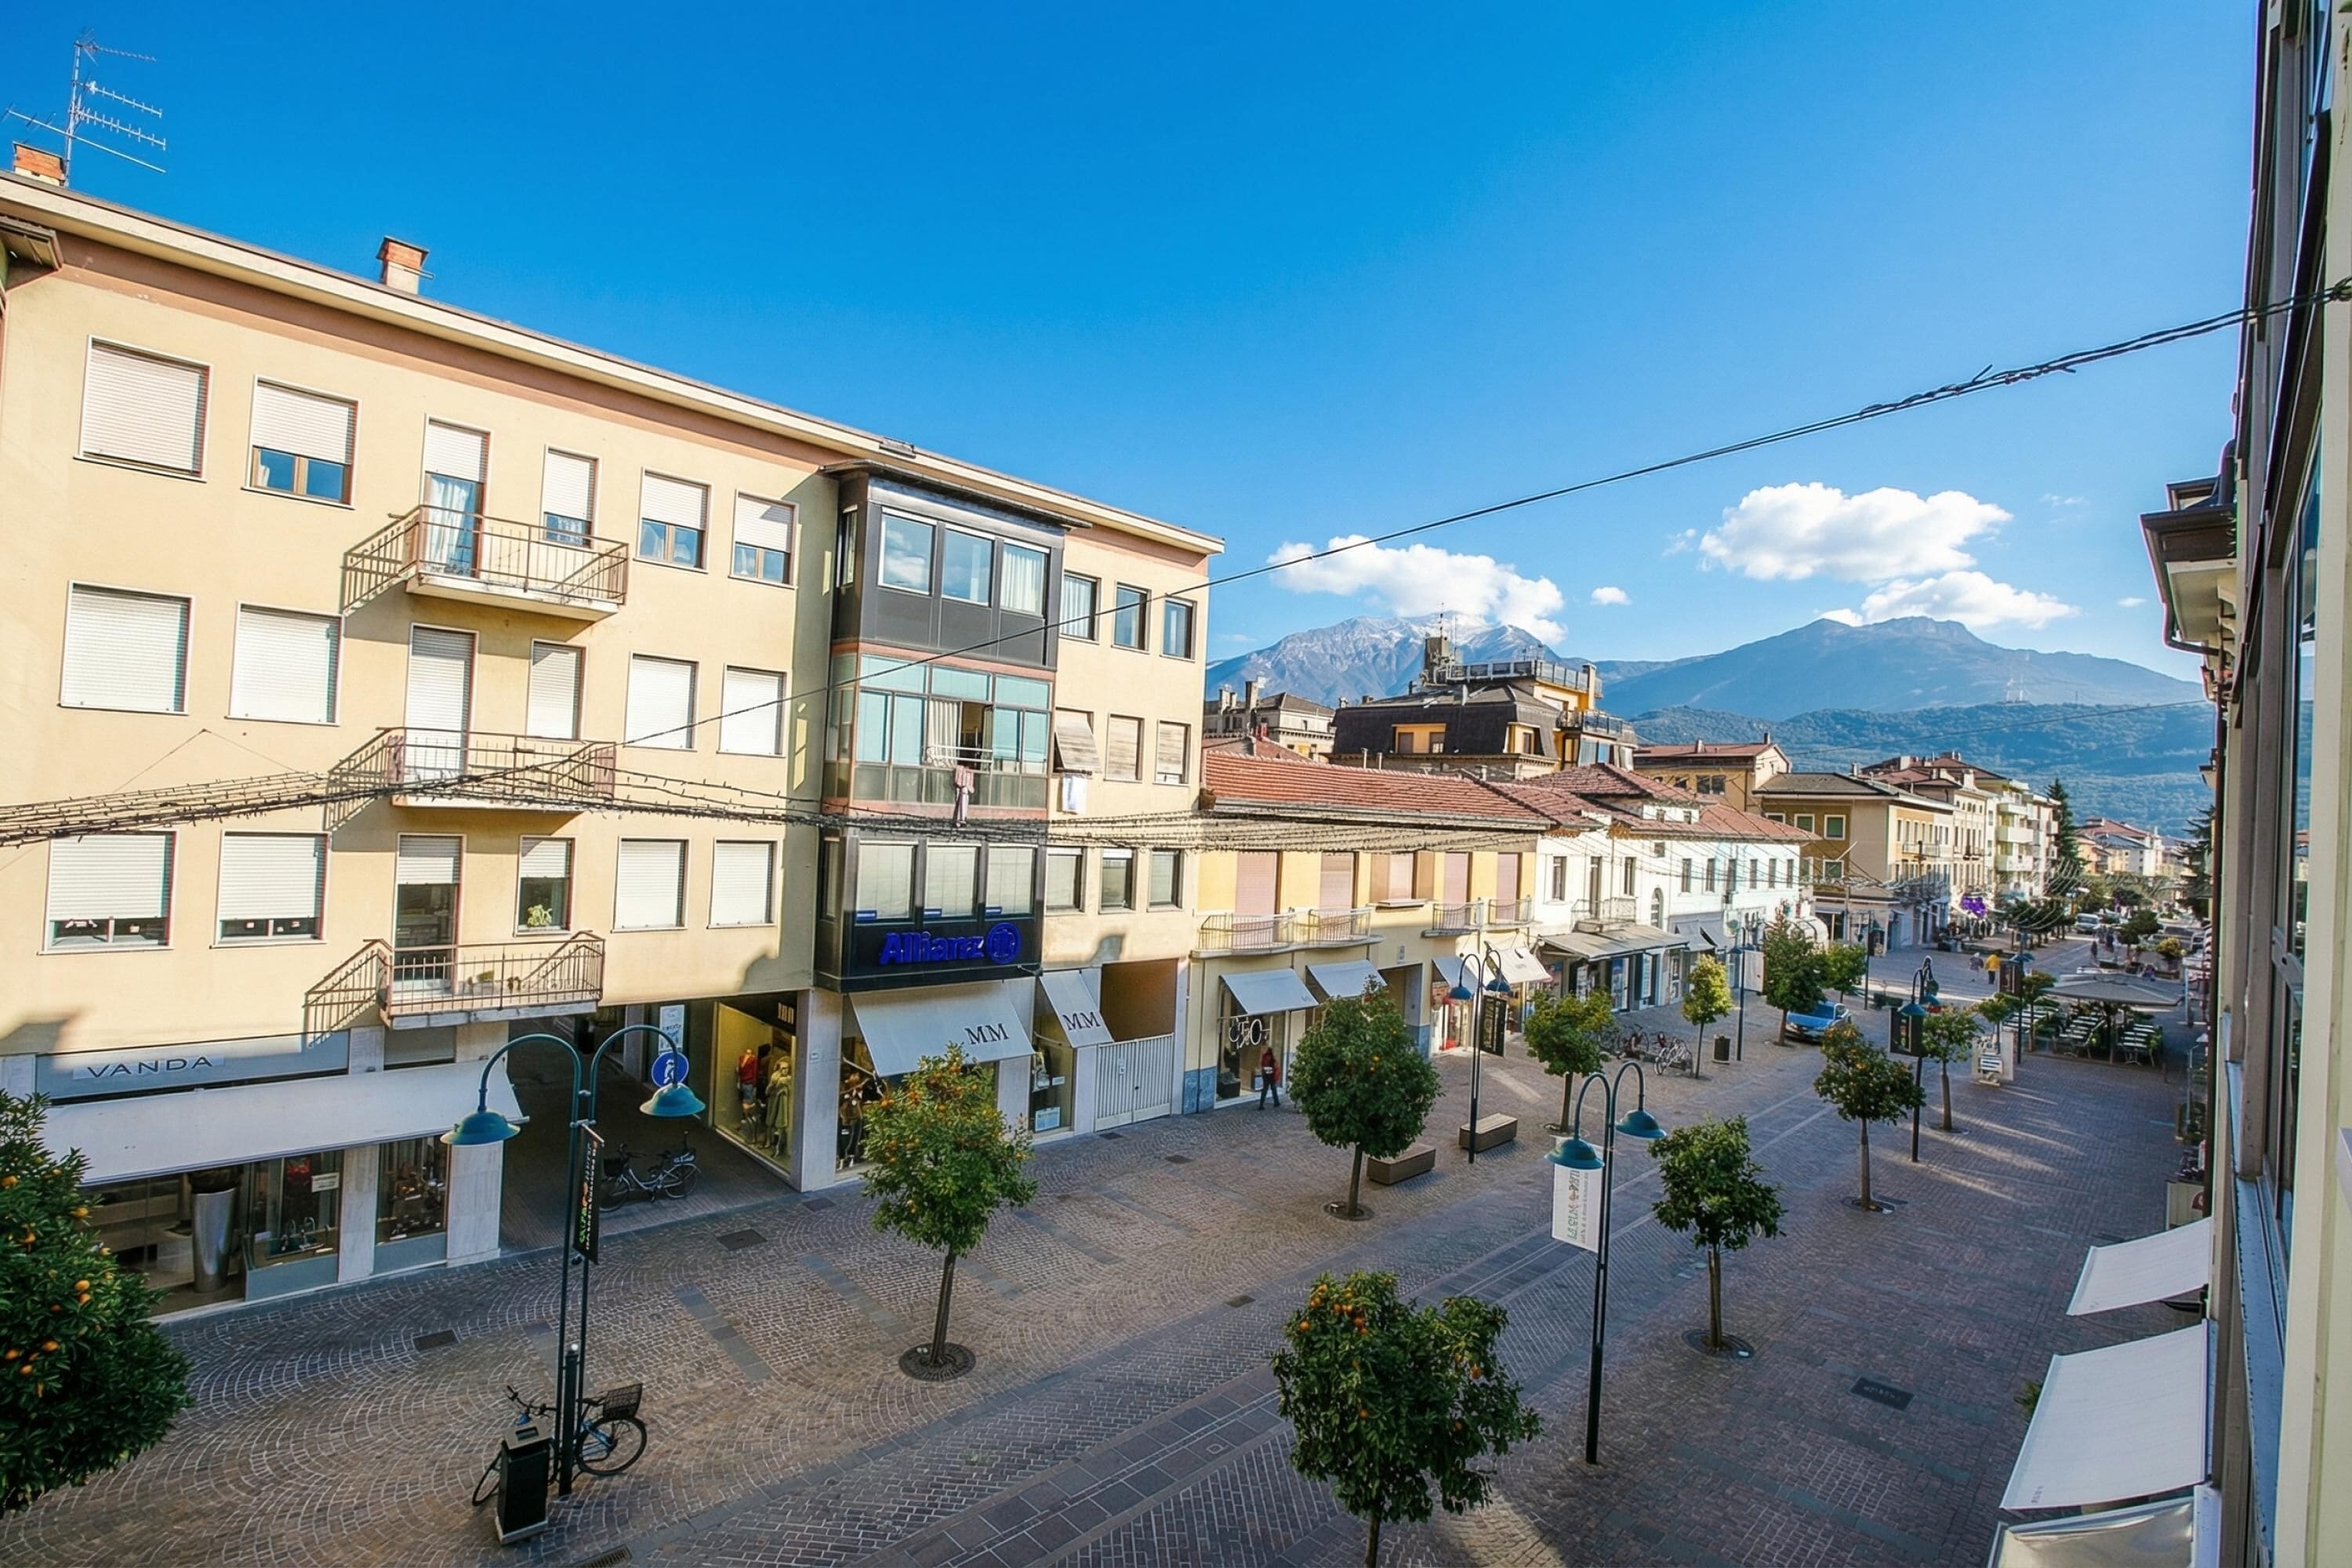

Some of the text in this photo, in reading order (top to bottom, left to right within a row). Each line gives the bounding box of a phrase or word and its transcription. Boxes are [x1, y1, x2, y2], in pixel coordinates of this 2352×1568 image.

[879, 931, 985, 966] Allianz
[1062, 1011, 1101, 1031] MM
[964, 1023, 1010, 1045] MM
[87, 1056, 213, 1078] VANDA
